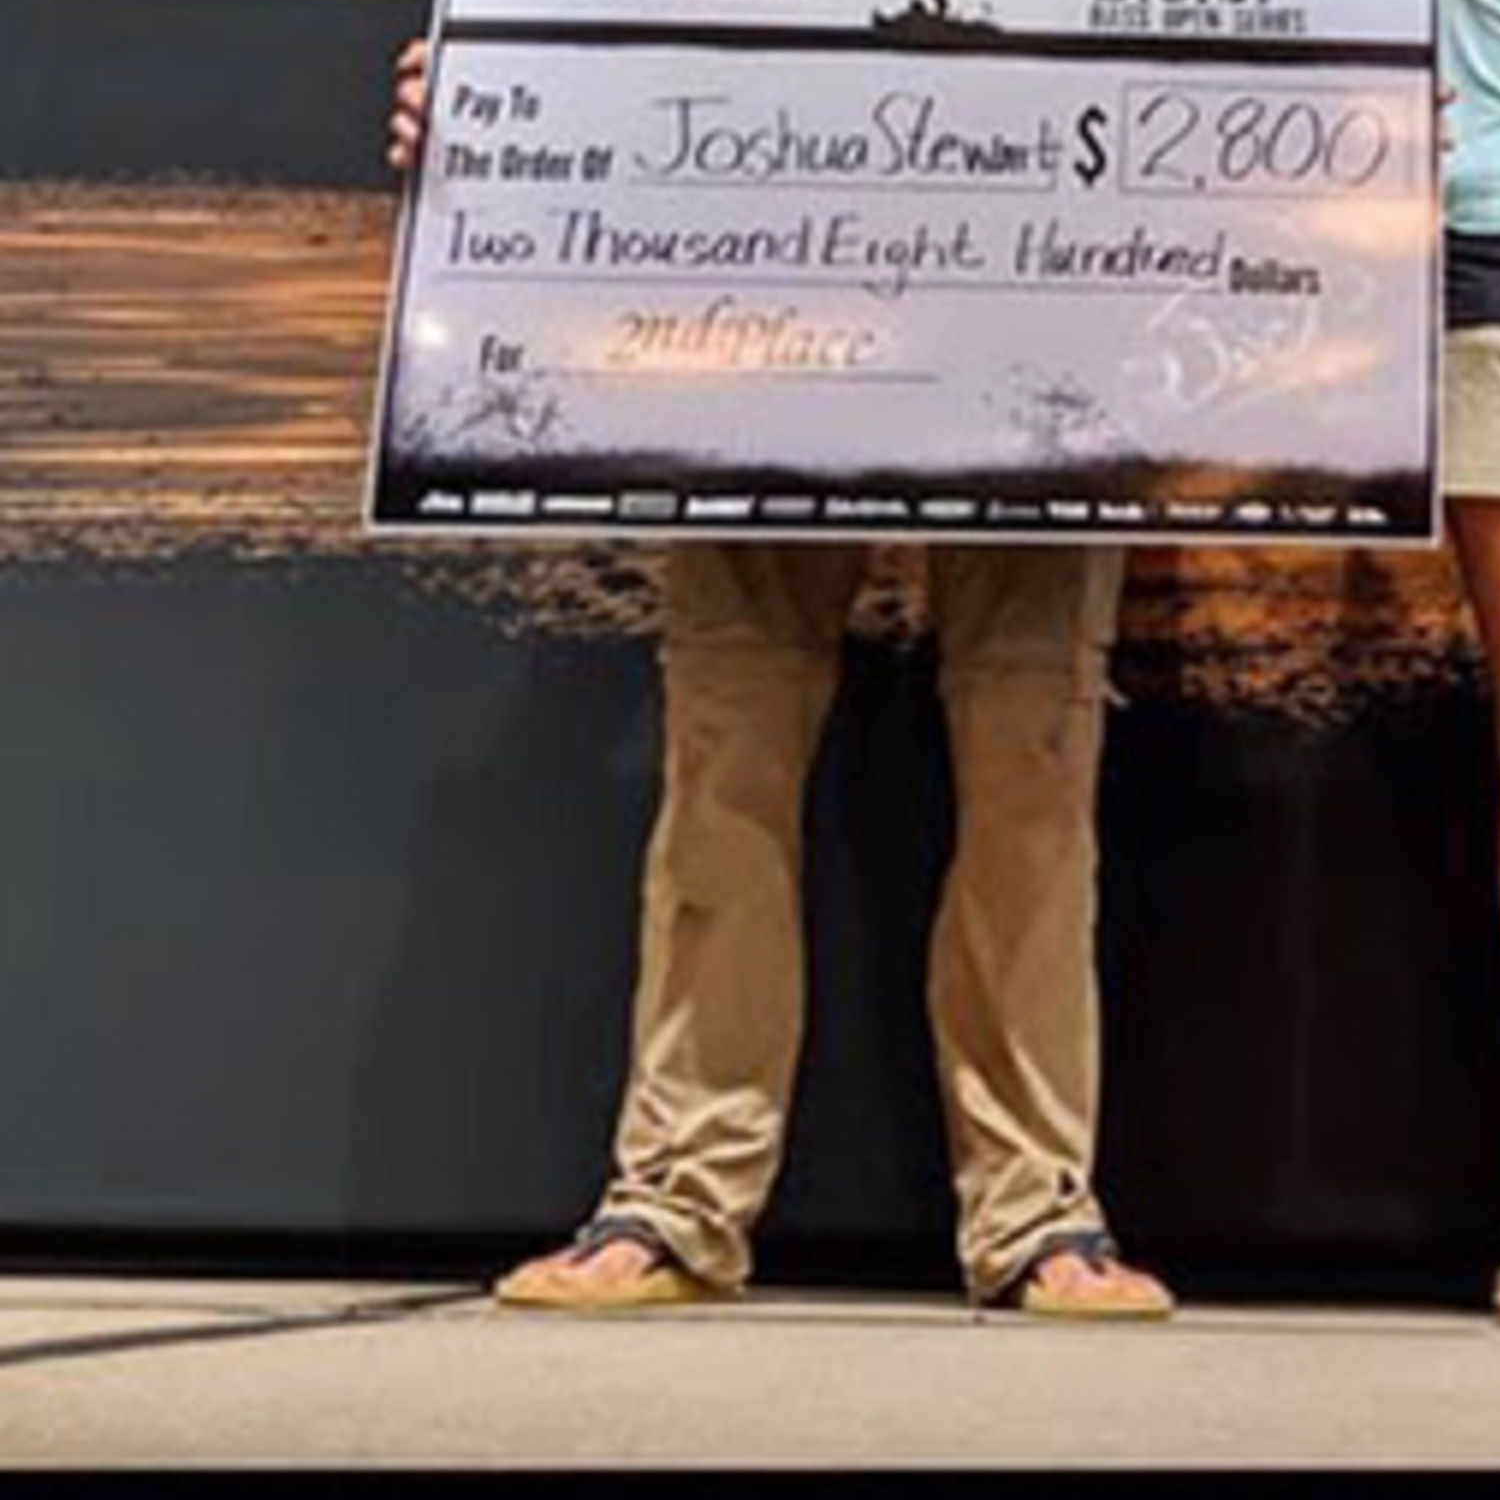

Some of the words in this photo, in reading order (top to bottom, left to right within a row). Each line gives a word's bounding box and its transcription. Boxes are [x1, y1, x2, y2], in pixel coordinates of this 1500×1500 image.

[445, 145, 494, 181] The
[500, 146, 575, 182] Order
[633, 95, 870, 180] Joshua
[1074, 108, 1109, 190] $
[452, 85, 501, 124] Pay
[510, 86, 541, 122] To
[447, 208, 537, 266] Two
[551, 208, 811, 268] Thousand
[818, 212, 985, 300] Eight
[1014, 218, 1228, 282] Hundred
[1230, 257, 1323, 298] Dollars
